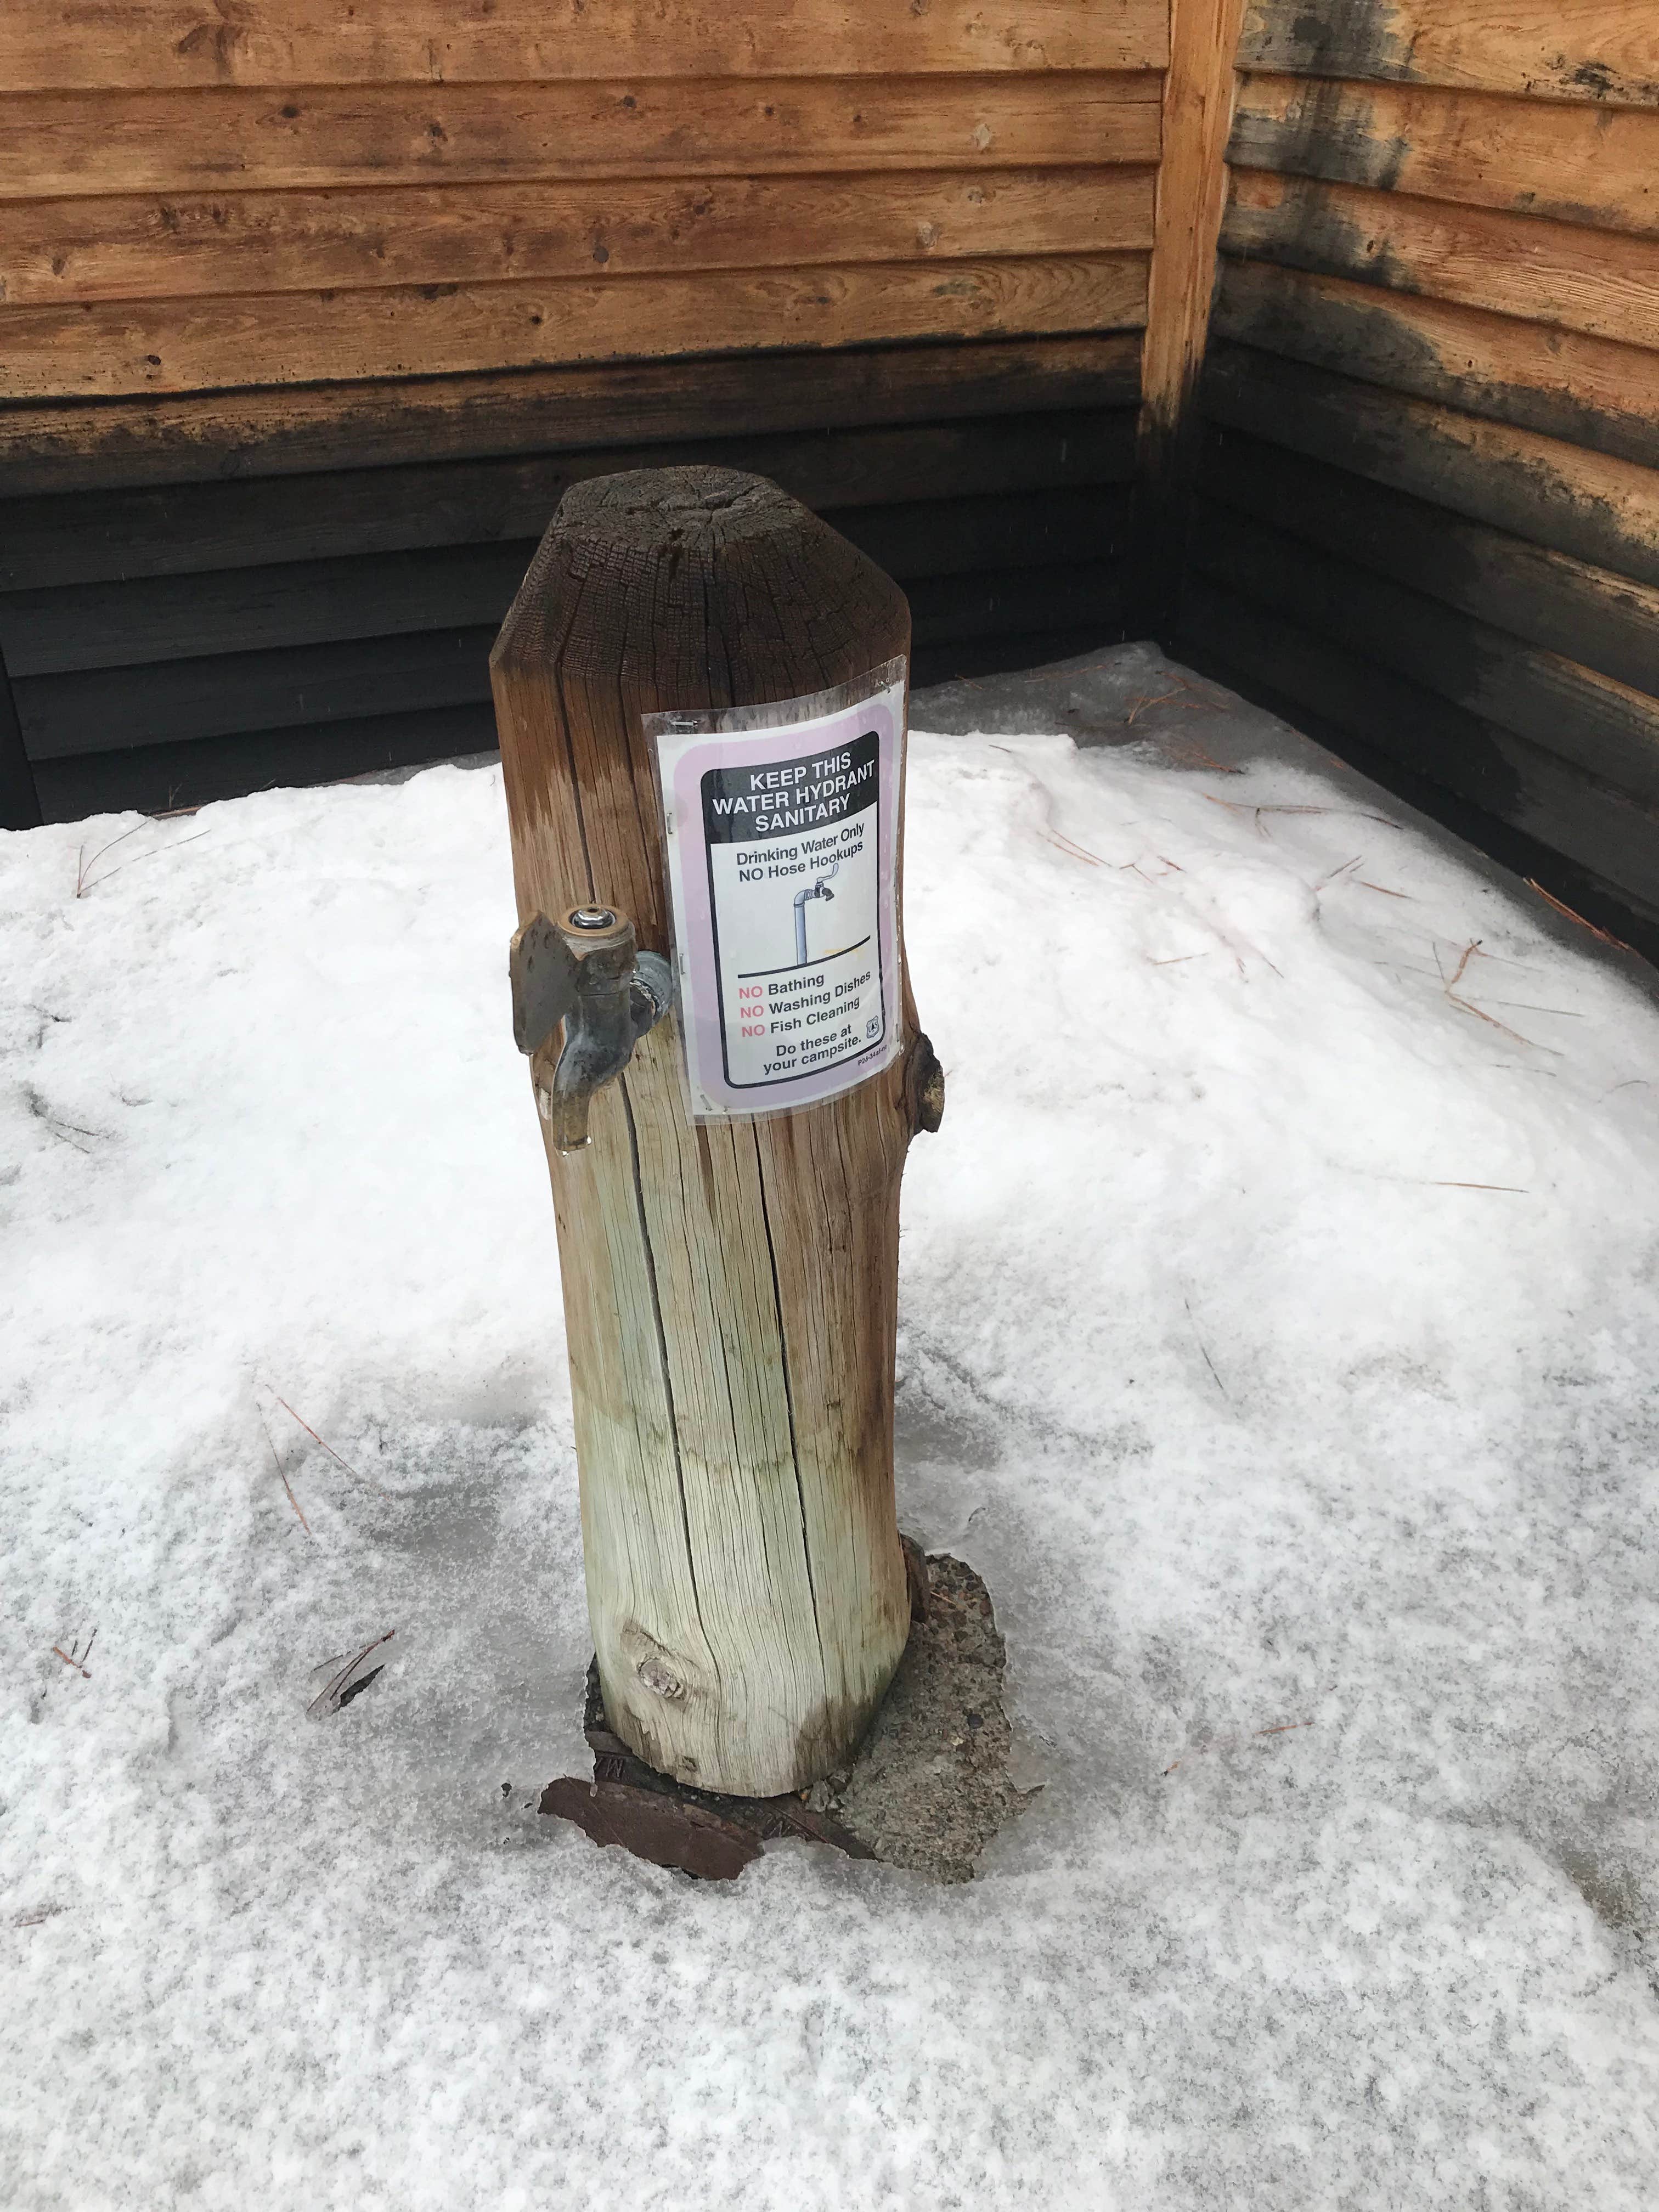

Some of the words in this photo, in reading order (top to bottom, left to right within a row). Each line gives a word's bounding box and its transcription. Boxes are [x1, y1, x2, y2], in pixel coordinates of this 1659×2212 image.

[712, 791, 789, 815] WATER
[796, 759, 875, 805] HYDRANT
[750, 766, 806, 791] KEEP
[811, 751, 851, 779] THIS
[755, 792, 850, 832] SANITARY
[737, 847, 798, 866] Drinking
[801, 834, 838, 855] Water
[840, 822, 865, 842] Only
[739, 868, 764, 883] NO
[768, 862, 806, 878] Hose
[810, 840, 864, 870] Hookups
[738, 986, 763, 1000] NO
[768, 974, 825, 996] Bathing
[740, 1005, 764, 1019] NO
[769, 991, 831, 1014] Washing
[835, 970, 871, 997] Dishes
[741, 1024, 765, 1037] NO
[770, 1018, 802, 1034] Fish
[806, 996, 860, 1025] Cleaning
[763, 1058, 797, 1075] your
[801, 1035, 861, 1065] campsite.
[776, 1044, 796, 1057] Do
[800, 1033, 837, 1051] these
[840, 1024, 852, 1037] at
